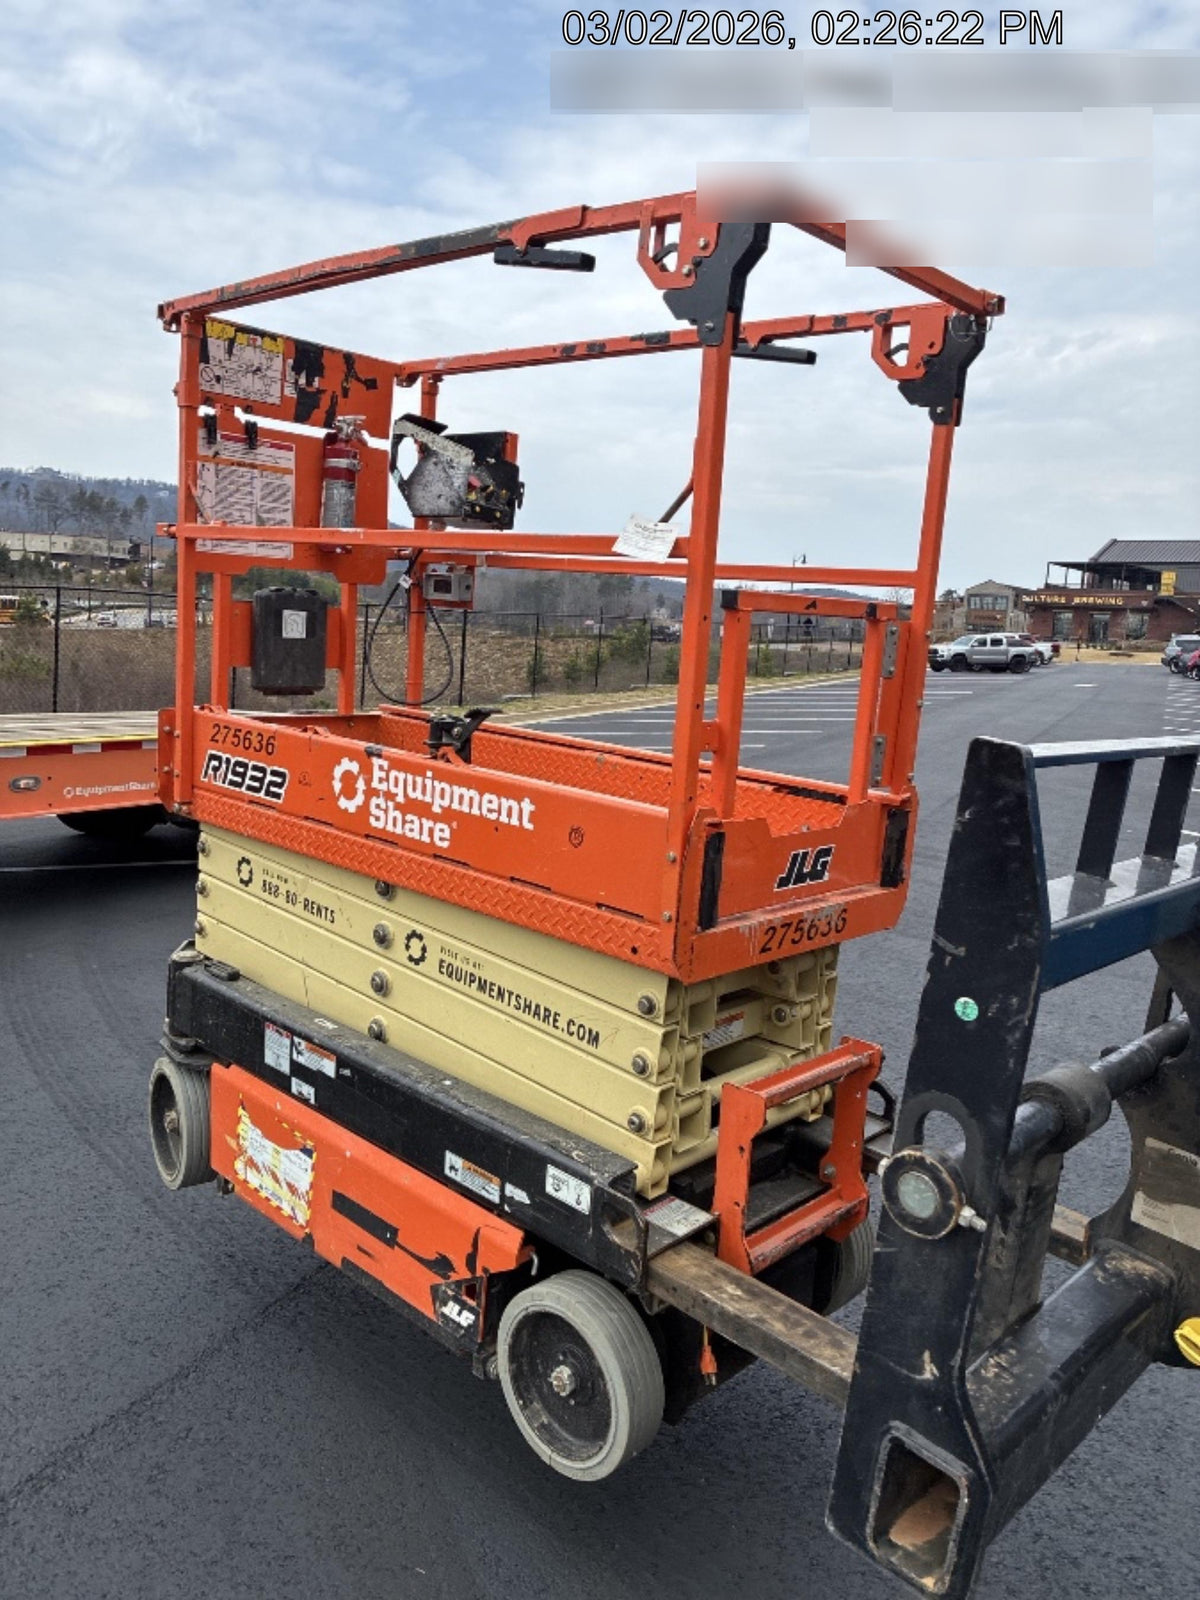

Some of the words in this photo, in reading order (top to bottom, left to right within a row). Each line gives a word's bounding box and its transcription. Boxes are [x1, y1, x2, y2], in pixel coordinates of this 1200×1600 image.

[209, 723, 276, 756] 275636
[201, 749, 289, 803] R1932
[371, 757, 536, 830] Equipment
[773, 844, 836, 892] JLG
[759, 908, 848, 954] 275636
[438, 957, 600, 1049] EQUIPMENTSHARE.COM
